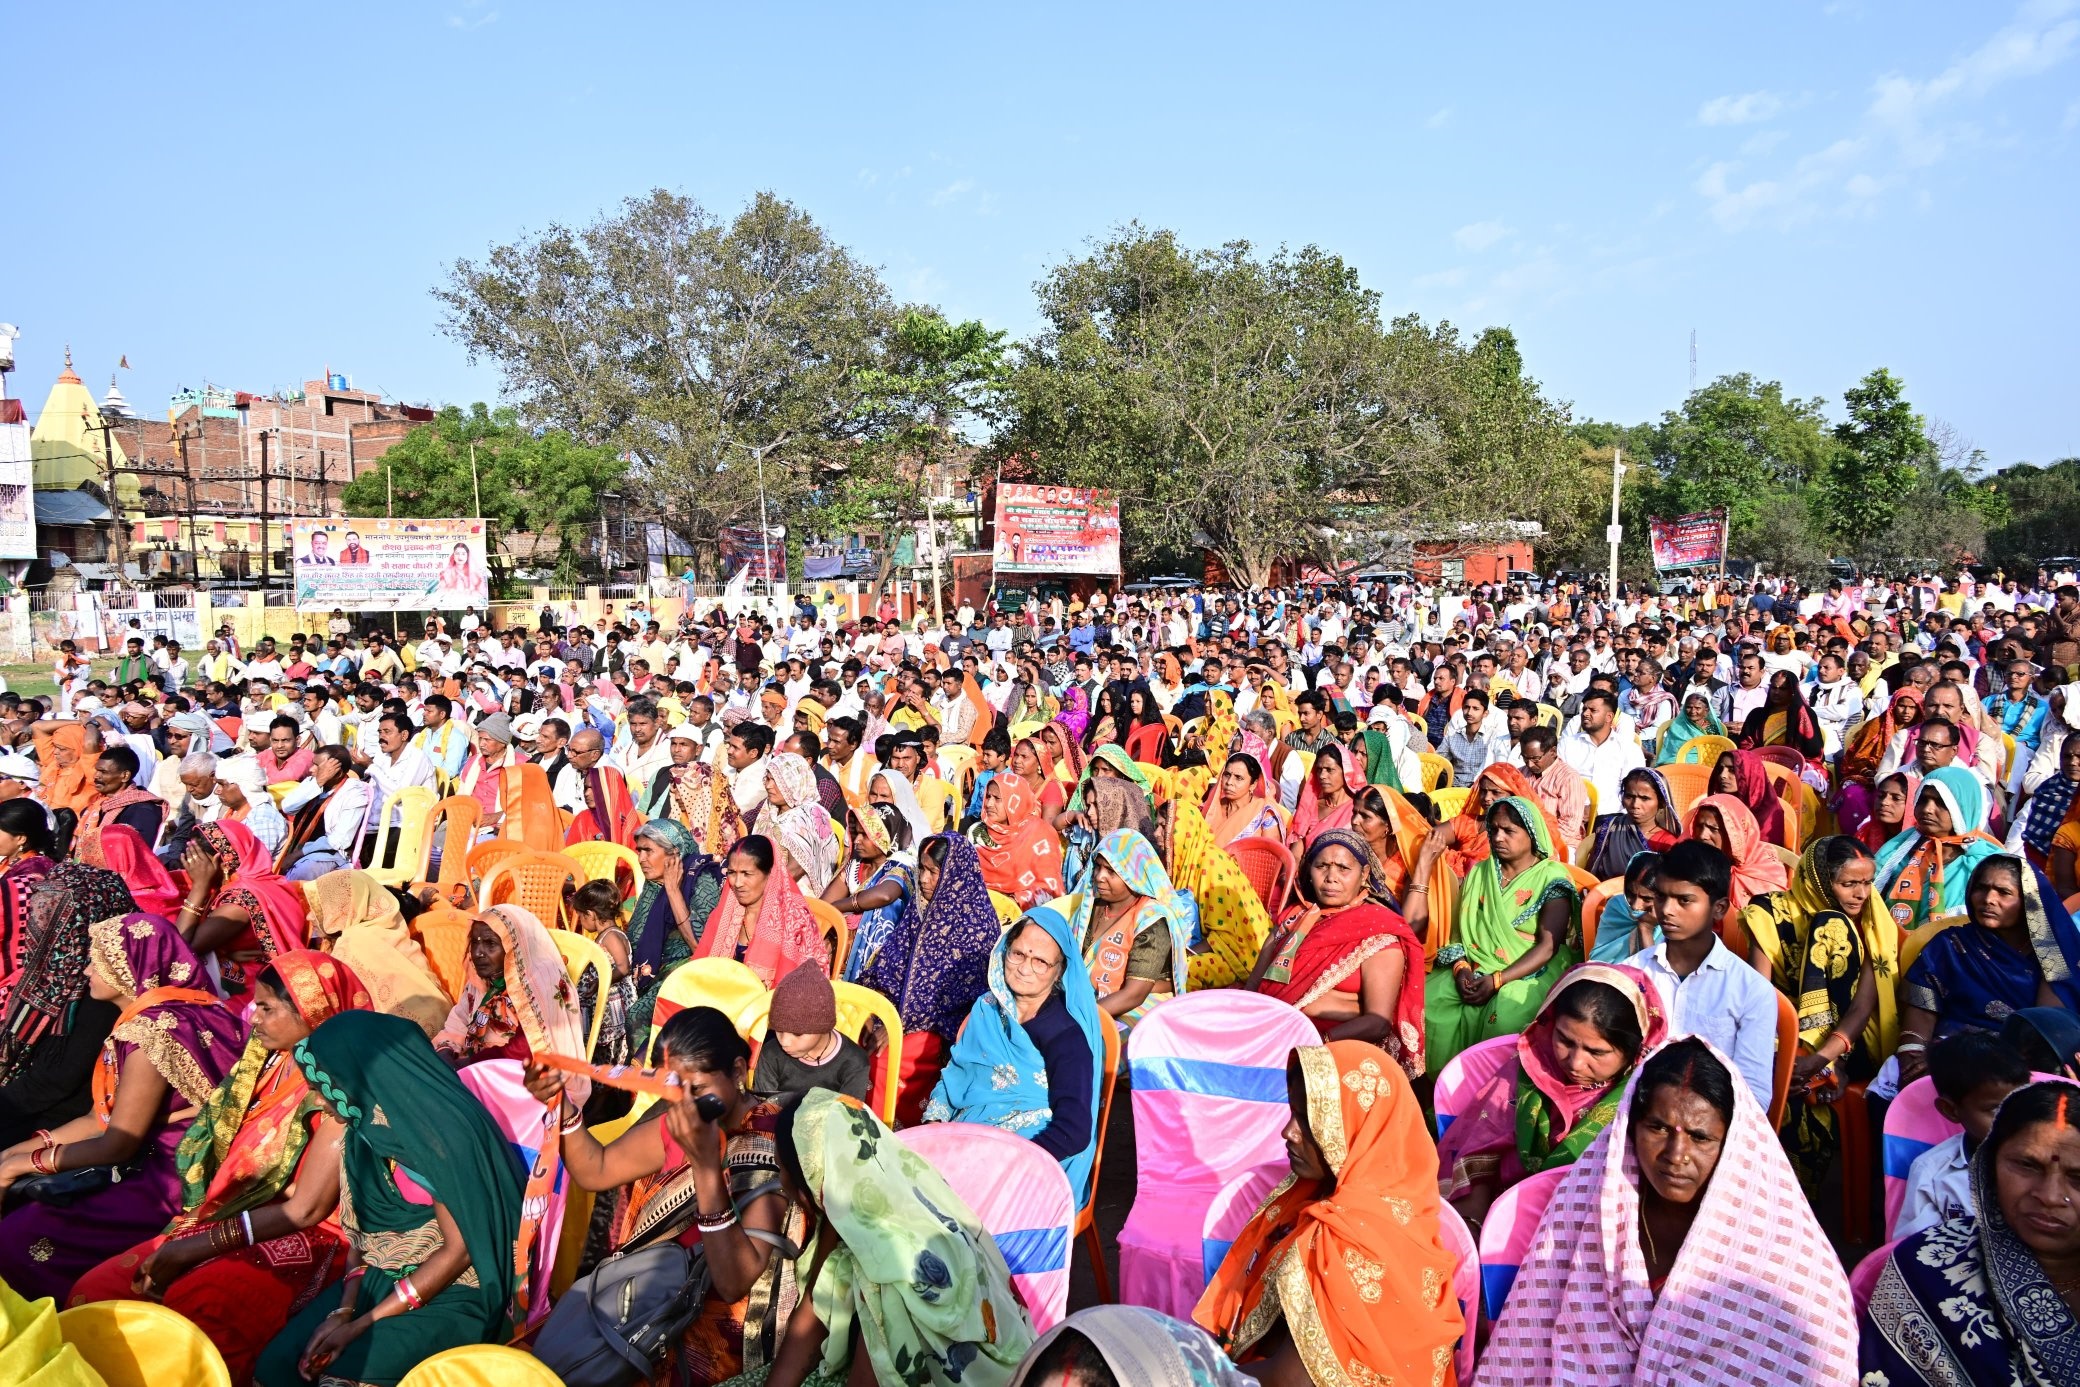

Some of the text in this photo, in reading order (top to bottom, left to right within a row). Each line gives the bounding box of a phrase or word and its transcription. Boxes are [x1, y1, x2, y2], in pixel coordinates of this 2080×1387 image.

[382, 543, 402, 551] केशव
[381, 561, 390, 569] श्री
[412, 562, 433, 570] चौधरी
[174, 611, 196, 622] अमृत
